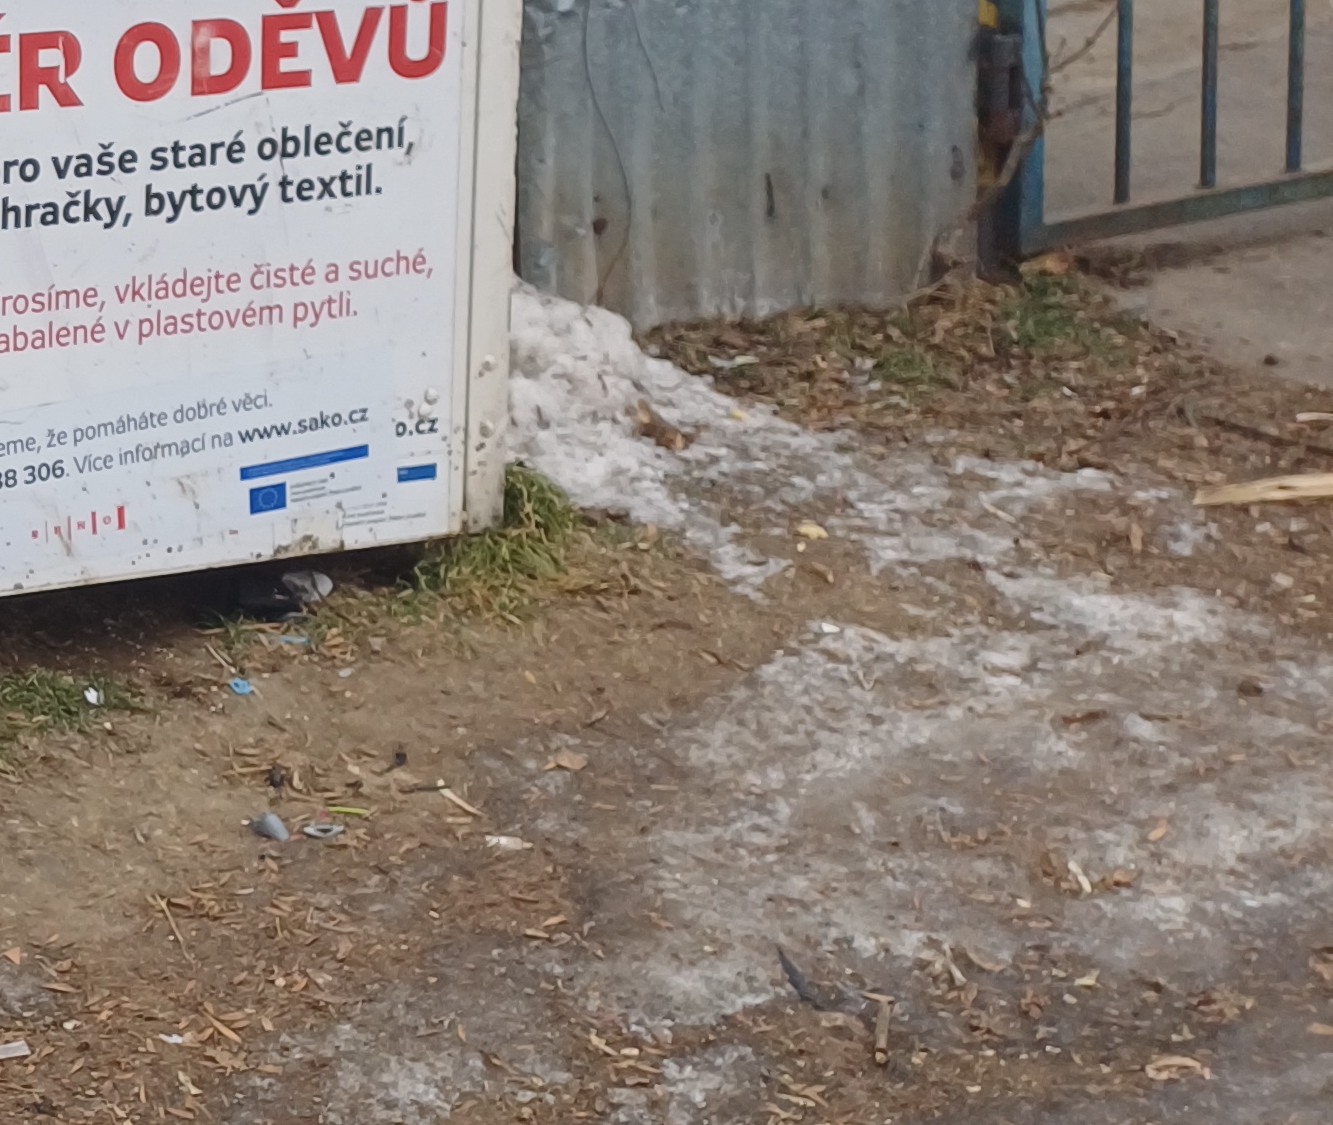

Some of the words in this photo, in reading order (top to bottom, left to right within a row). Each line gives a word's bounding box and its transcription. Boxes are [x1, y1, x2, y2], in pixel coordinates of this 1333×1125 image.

[51, 141, 138, 181] vaše
[150, 130, 246, 173] staré
[257, 116, 415, 161] oblečení,
[1, 189, 132, 231] hračky,
[143, 174, 268, 223] bytový
[278, 164, 382, 204] textil.
[114, 269, 242, 307] vkládejte
[250, 259, 317, 292] čisté
[324, 266, 340, 286] a
[348, 248, 433, 279] suché,
[113, 321, 130, 340] v
[136, 300, 283, 344] plastovém
[292, 291, 358, 327] pytli.
[23, 459, 70, 484] 306.
[73, 451, 114, 475] Více
[118, 432, 206, 468] informací
[211, 431, 233, 448] na
[237, 407, 369, 443] www.sako.cz
[46, 428, 68, 448] že
[72, 411, 169, 449] pomáháte
[173, 398, 227, 424] dobré
[232, 390, 273, 414] věci.
